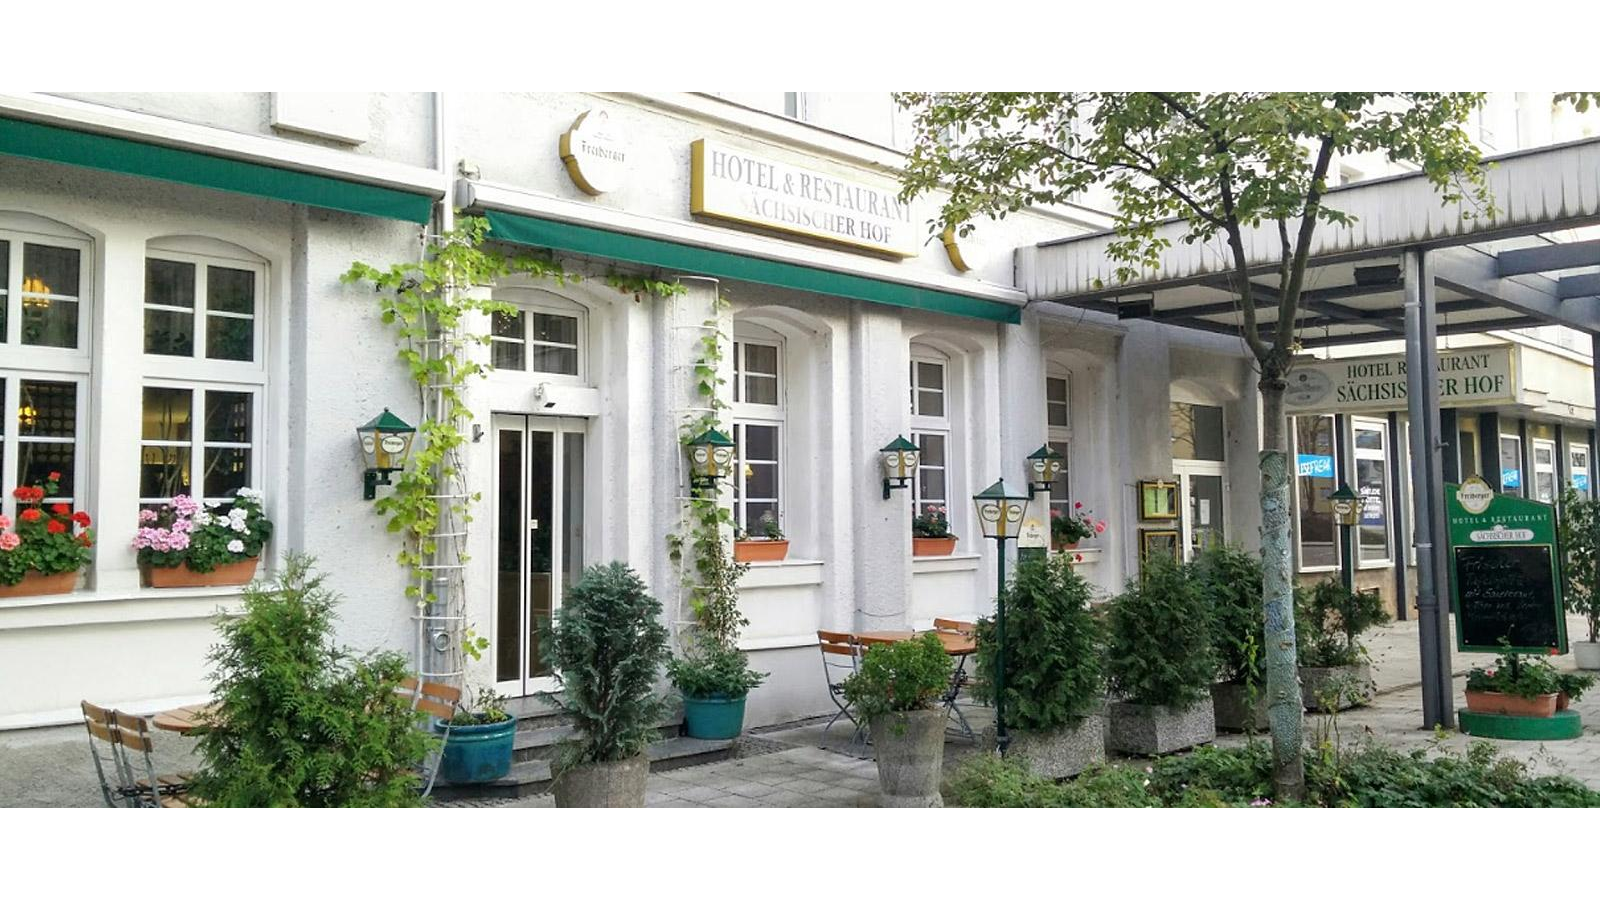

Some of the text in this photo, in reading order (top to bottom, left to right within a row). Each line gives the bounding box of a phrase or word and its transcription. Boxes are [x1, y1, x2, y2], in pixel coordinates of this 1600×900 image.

[712, 150, 778, 191] HOTEL
[783, 173, 794, 195] &
[743, 190, 891, 243] SÄCHSISCHER HOF
[1347, 362, 1392, 378] HOTEL
[1464, 375, 1504, 395] HOF
[1491, 514, 1548, 522] RESTAURANT
